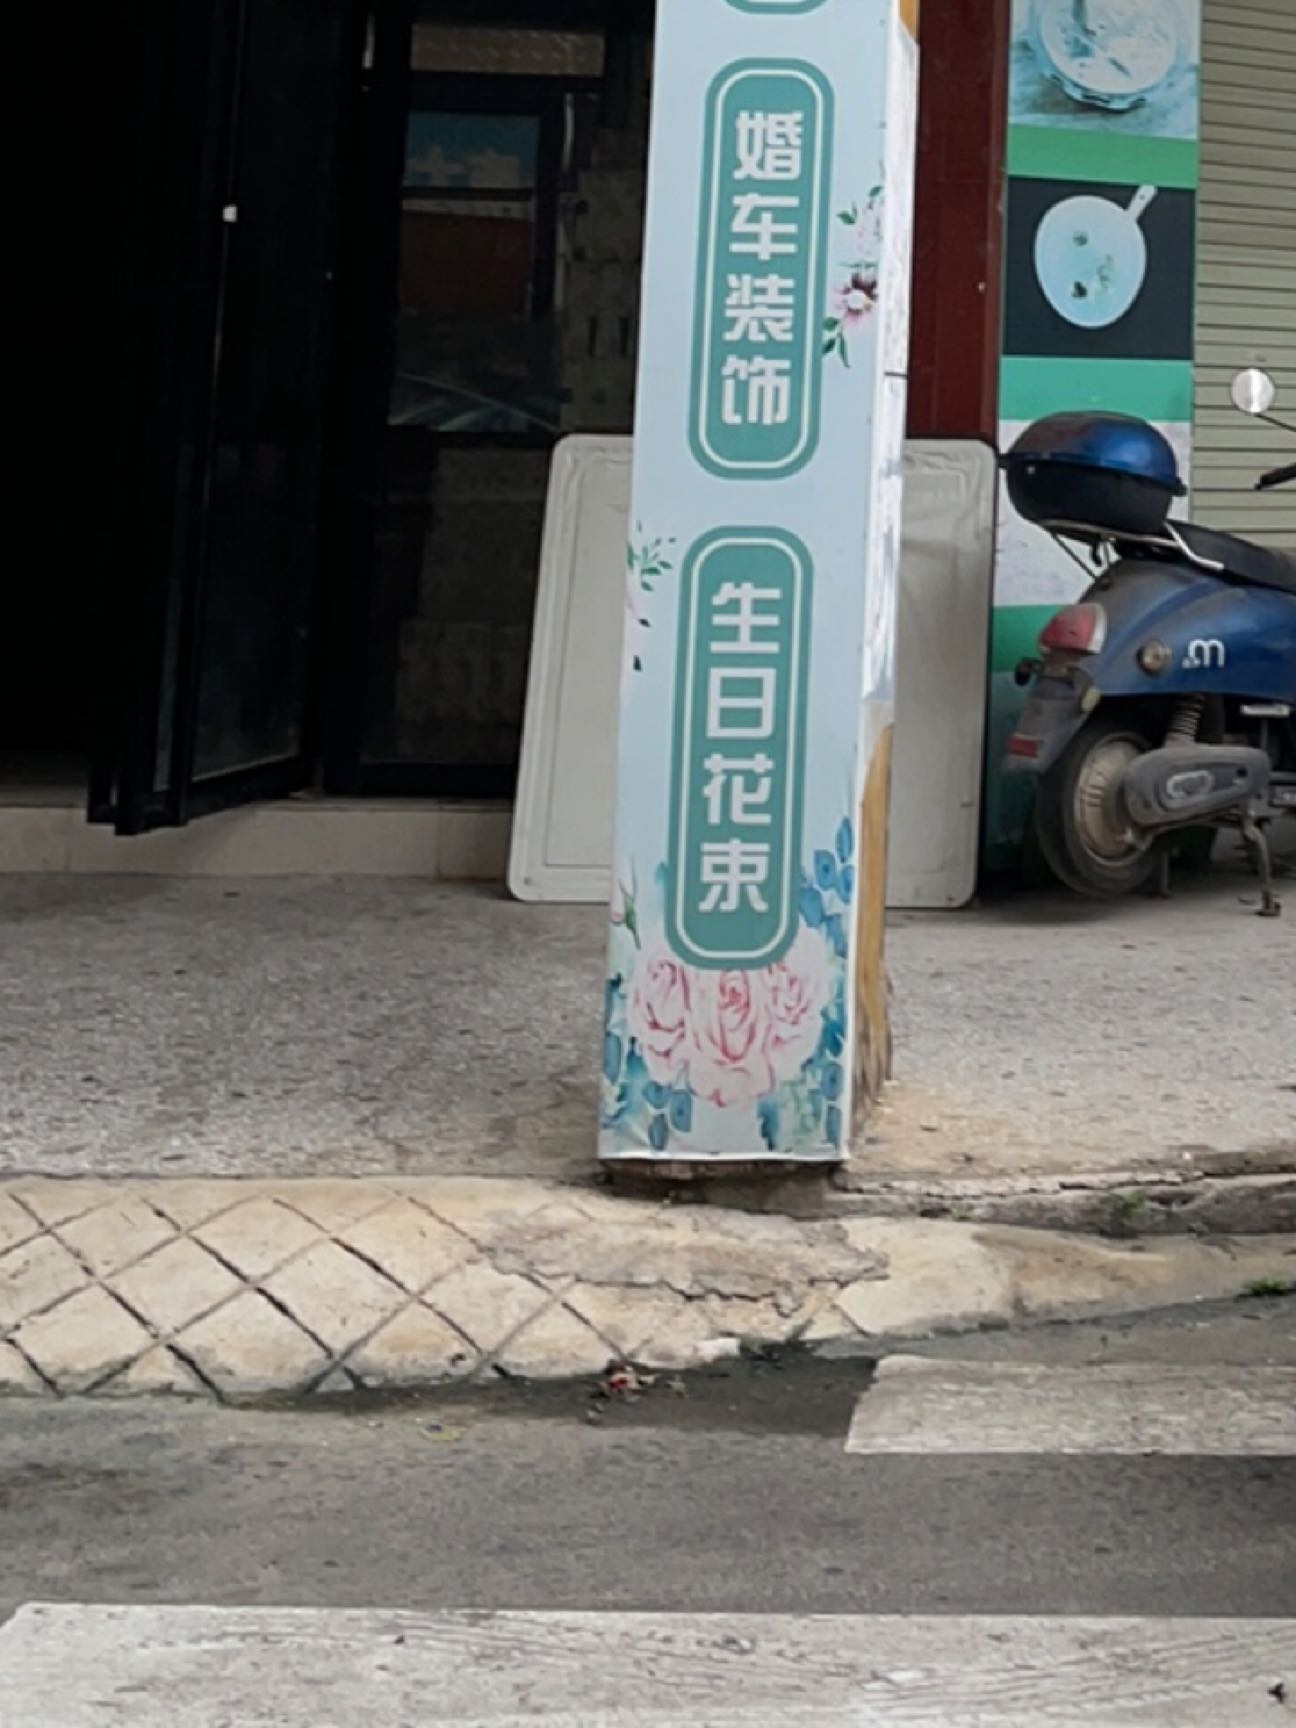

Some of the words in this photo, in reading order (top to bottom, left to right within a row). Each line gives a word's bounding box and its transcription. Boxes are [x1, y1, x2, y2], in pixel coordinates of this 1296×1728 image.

[720, 110, 804, 427] 婚车装饰
[699, 581, 783, 913] 生日花束
